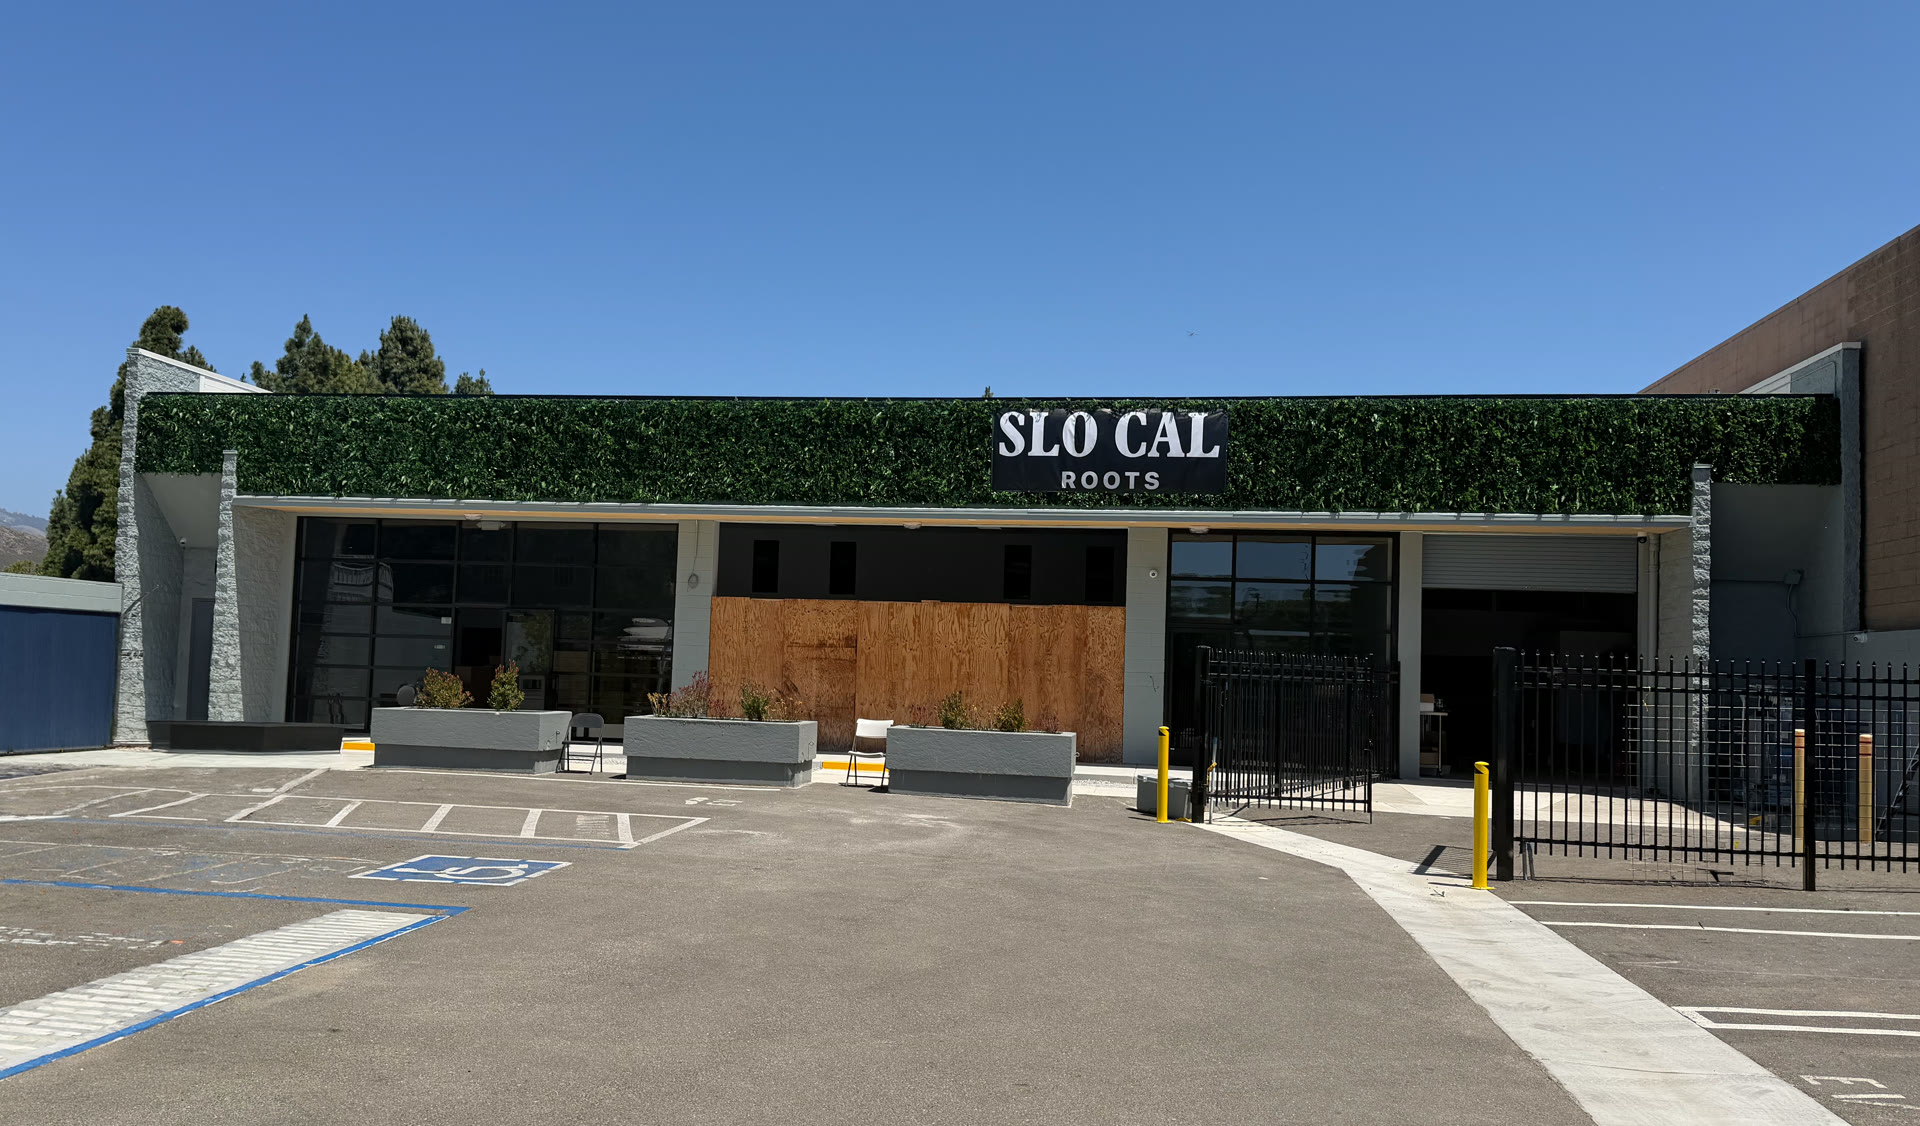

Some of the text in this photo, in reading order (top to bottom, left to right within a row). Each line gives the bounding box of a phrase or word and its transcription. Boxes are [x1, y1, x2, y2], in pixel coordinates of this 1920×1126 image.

[998, 411, 1221, 458] SLO CAL
[1061, 470, 1160, 490] ROOTS
